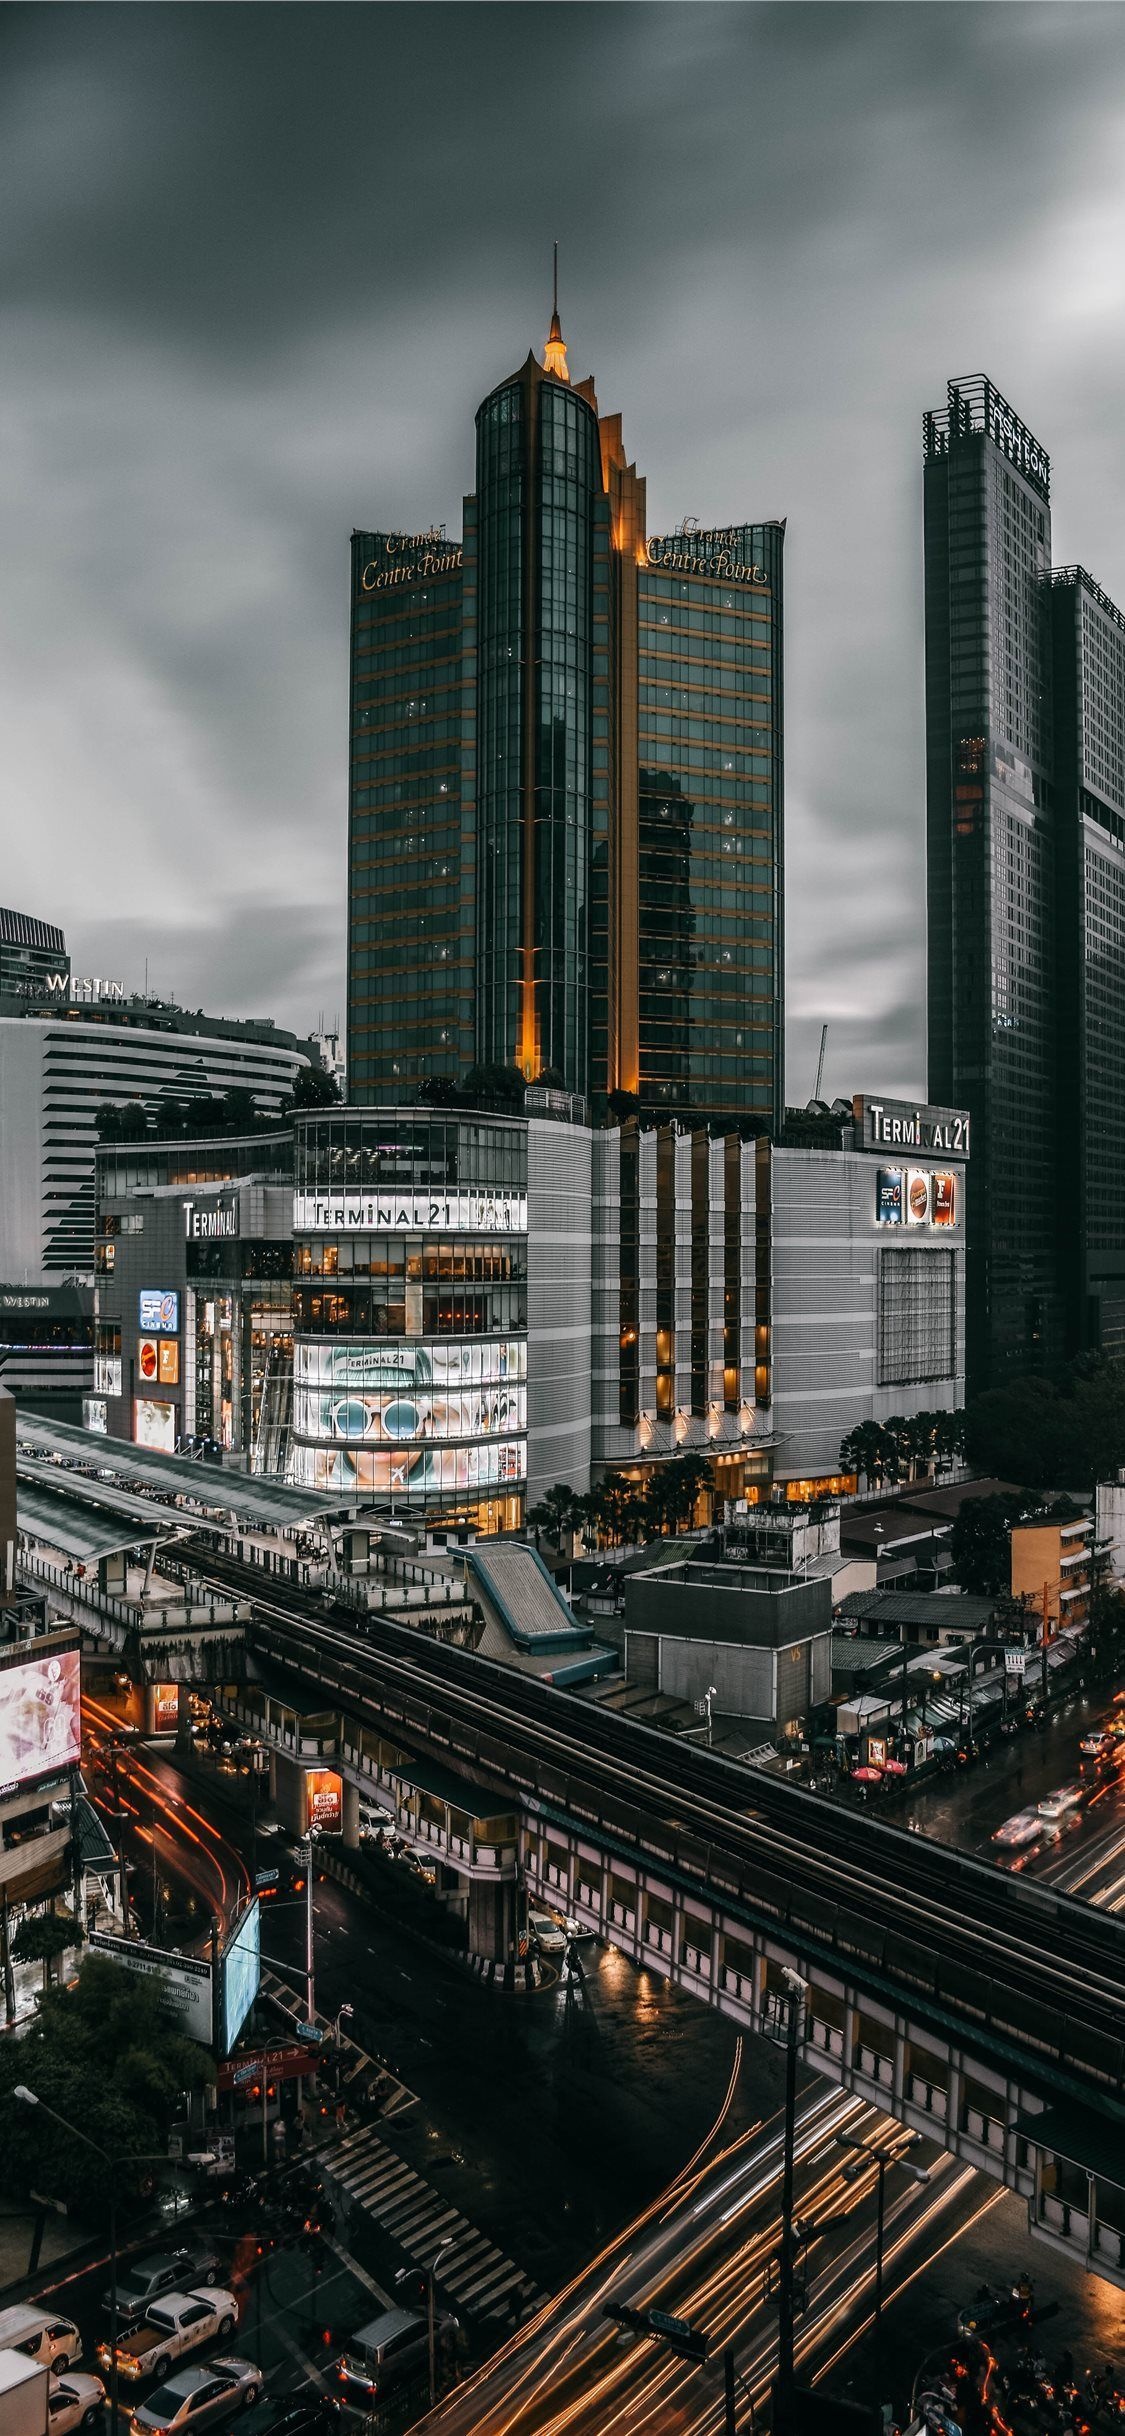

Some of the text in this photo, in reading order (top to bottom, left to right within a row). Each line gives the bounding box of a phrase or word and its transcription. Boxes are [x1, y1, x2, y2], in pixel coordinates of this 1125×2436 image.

[993, 406, 1047, 484] ASHTON
[362, 547, 463, 590] Centre Point
[646, 536, 768, 583] Centre Point
[46, 973, 124, 996] WESTIN
[3, 1296, 50, 1308] WESTIN
